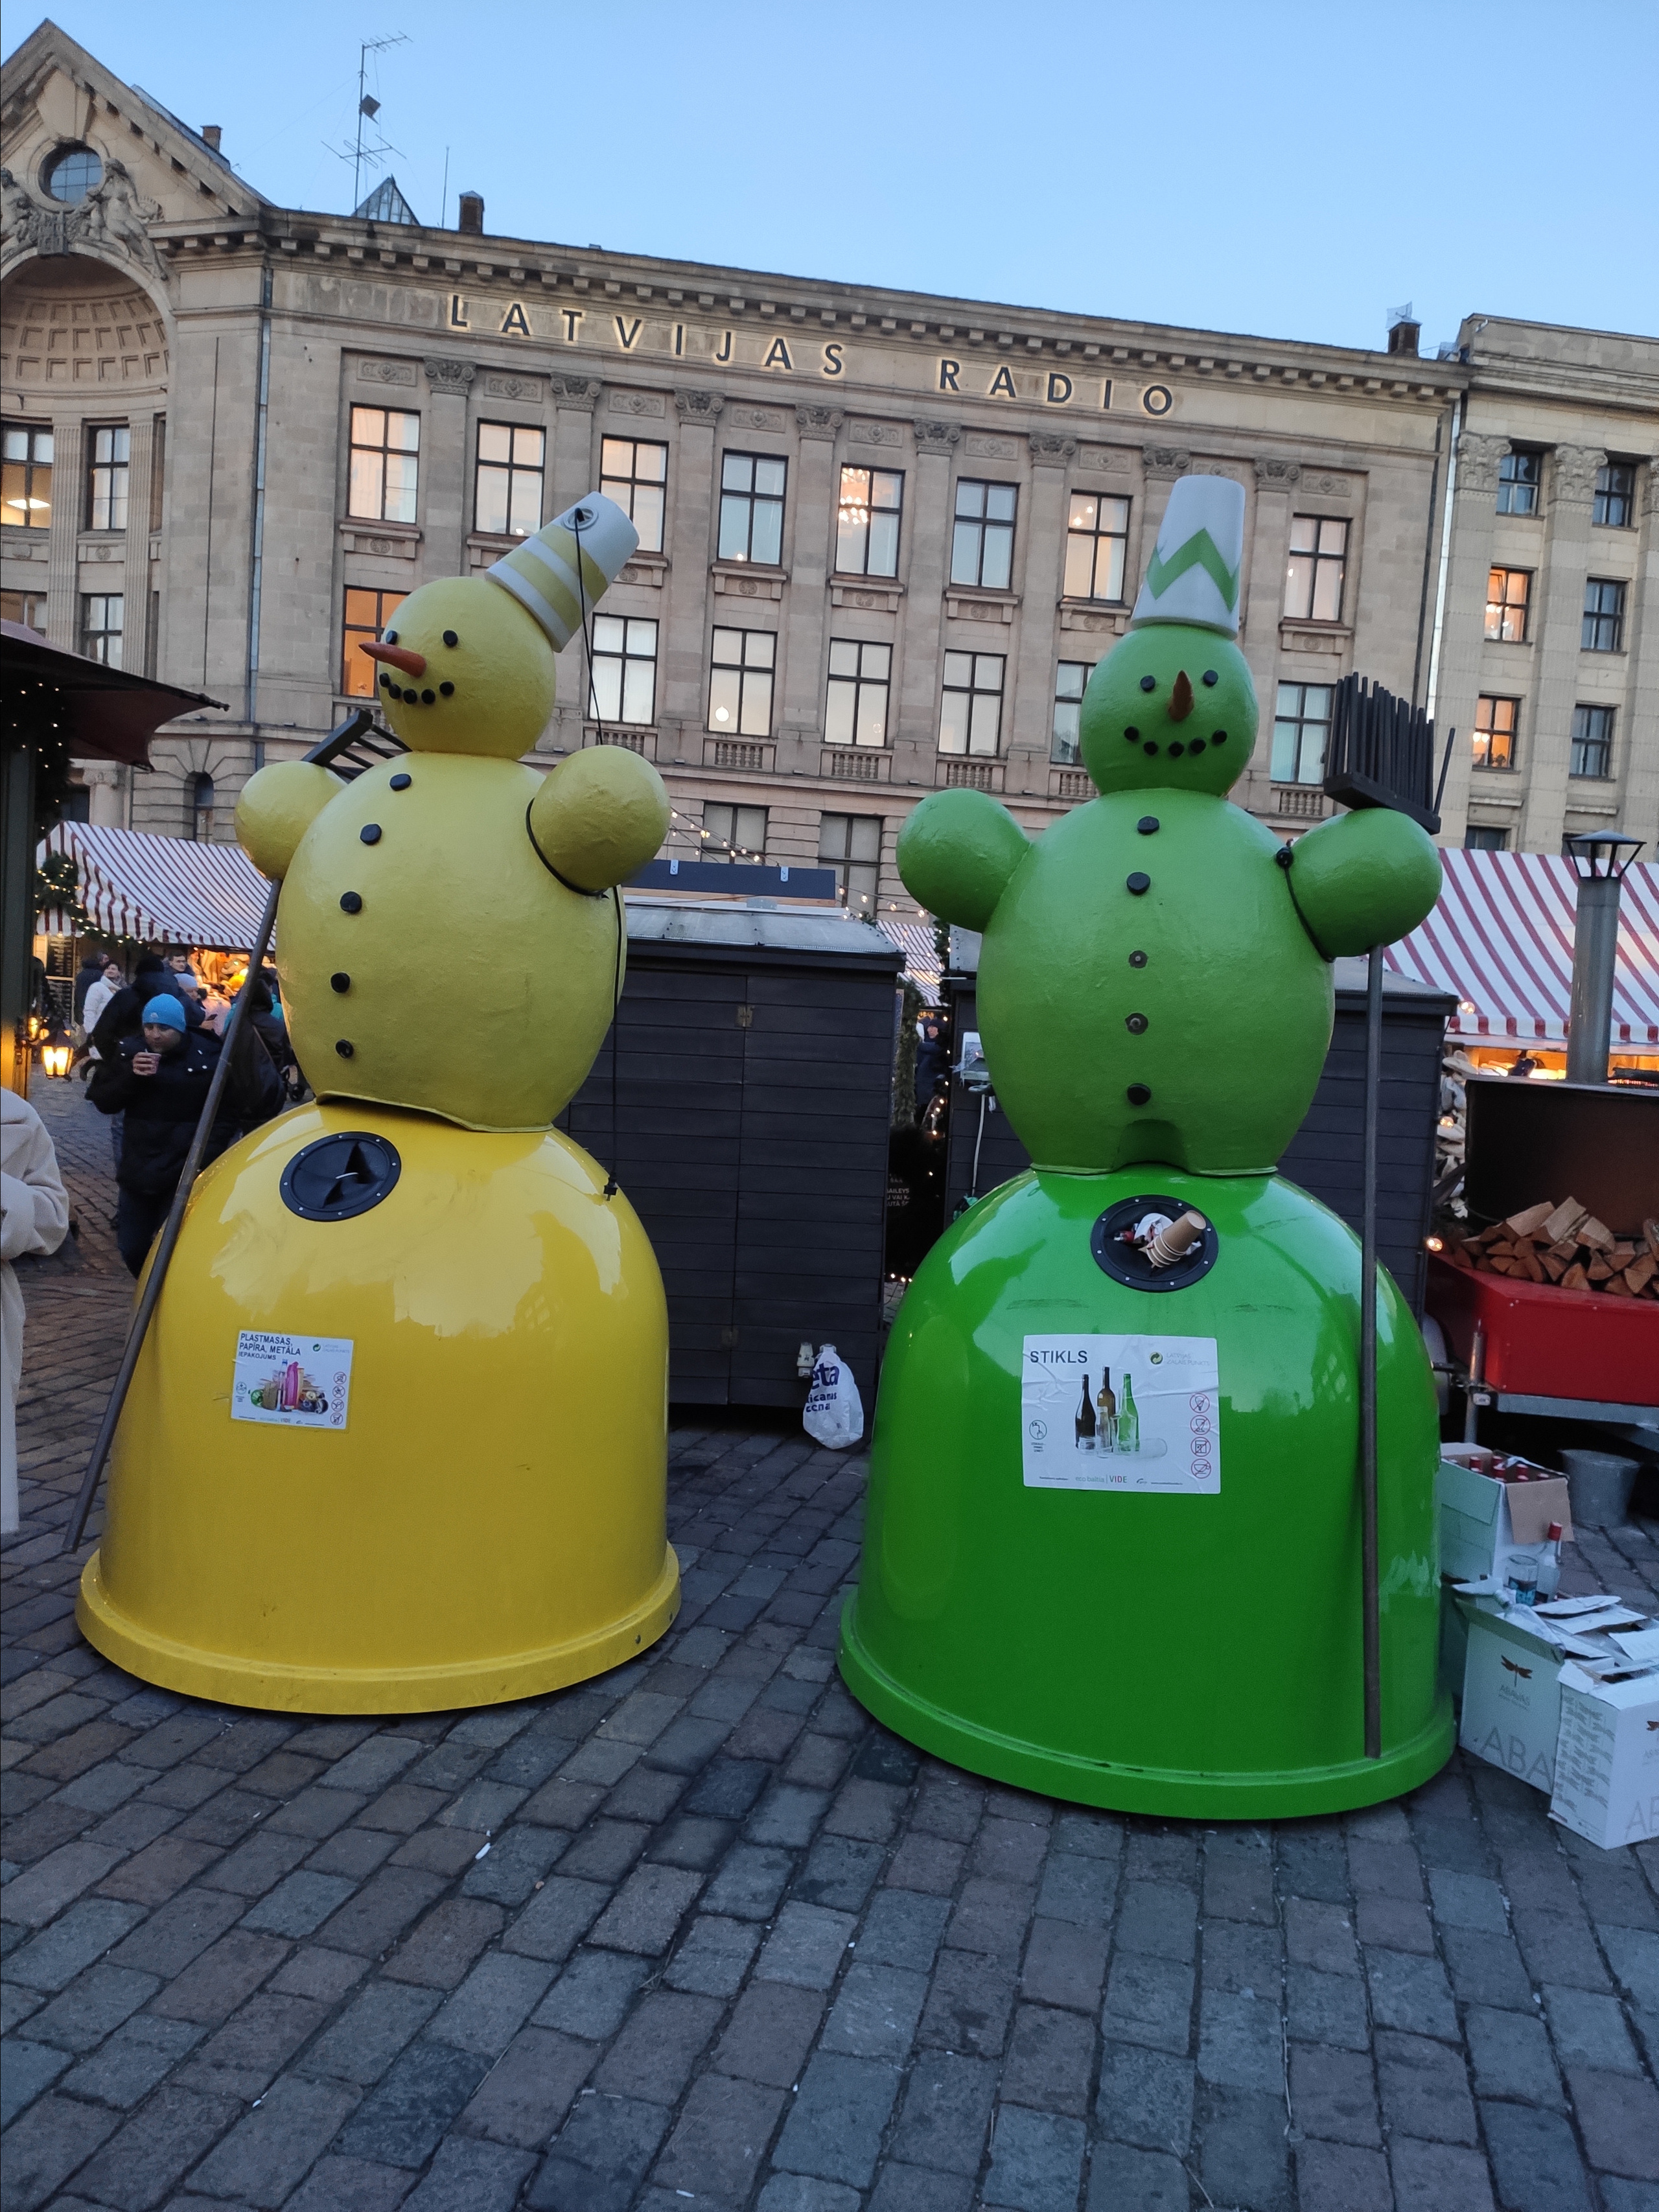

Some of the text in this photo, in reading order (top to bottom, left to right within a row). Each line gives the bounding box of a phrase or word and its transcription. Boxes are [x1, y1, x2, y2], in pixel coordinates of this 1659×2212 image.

[450, 295, 1173, 416] LATVIJAS RADIO
[240, 1333, 293, 1346] PLASTMASAS,
[239, 1342, 301, 1355] PAPĪRA, METĀLA
[1030, 1350, 1087, 1364] STIKLS
[806, 1403, 831, 1412] cena
[1109, 1475, 1128, 1484] VIDE
[1480, 1727, 1556, 1793] ABA
